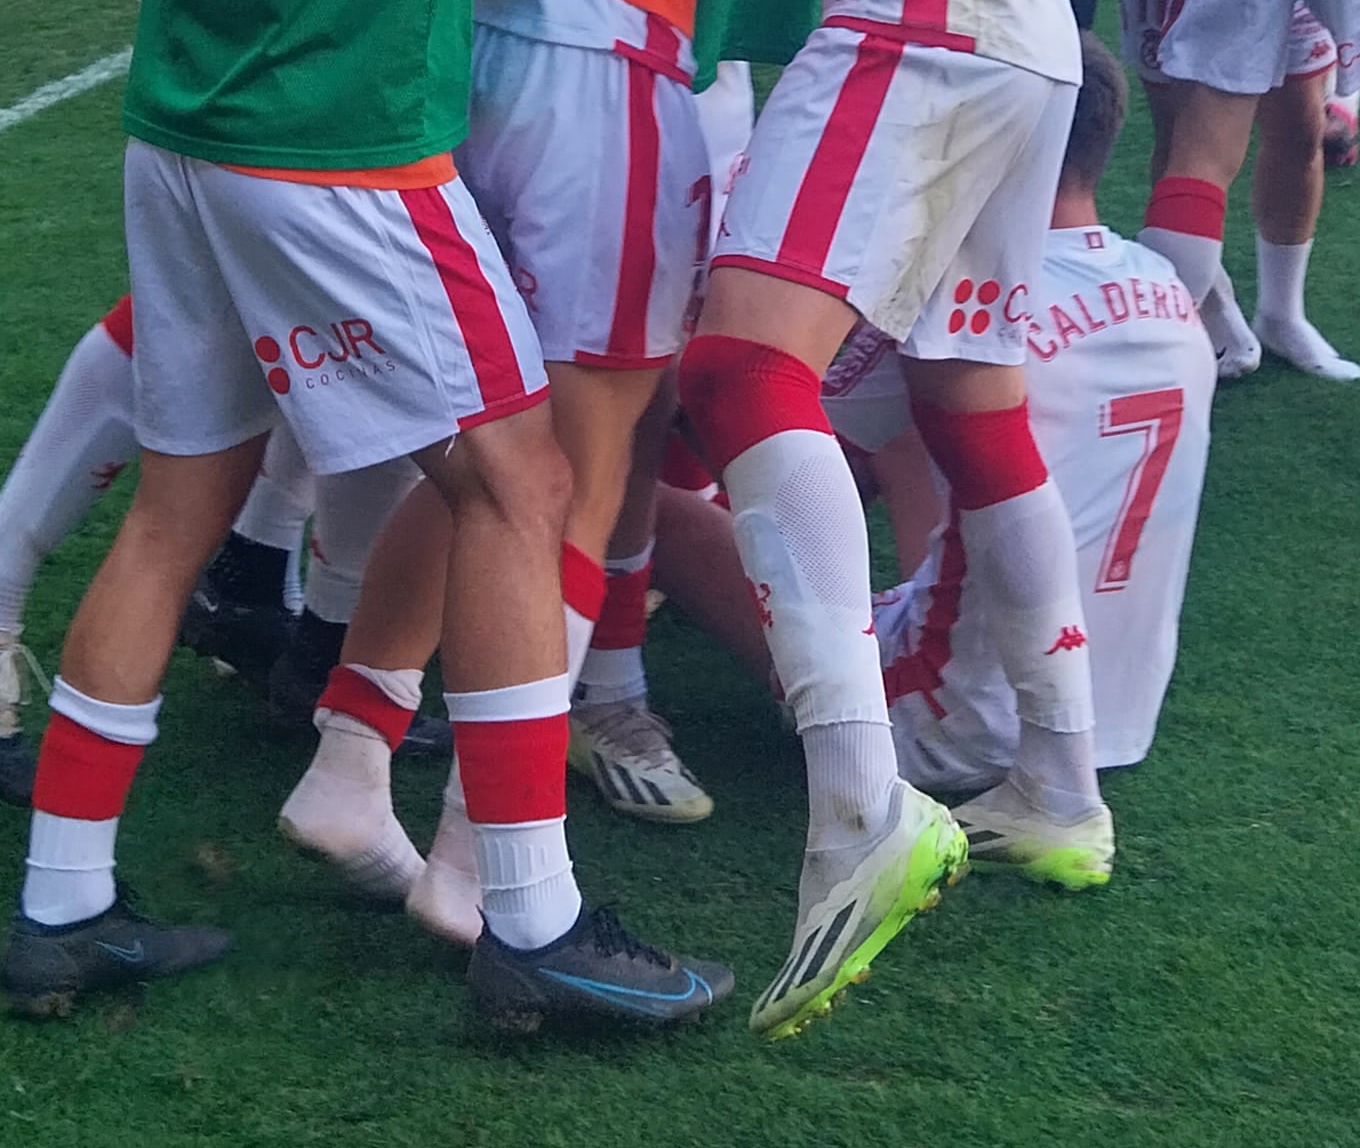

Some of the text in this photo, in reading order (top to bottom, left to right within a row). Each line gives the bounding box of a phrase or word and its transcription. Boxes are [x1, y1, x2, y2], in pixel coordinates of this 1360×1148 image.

[288, 318, 386, 370] CJR
[305, 360, 396, 389] COCINAS
[1094, 387, 1185, 594] 7
